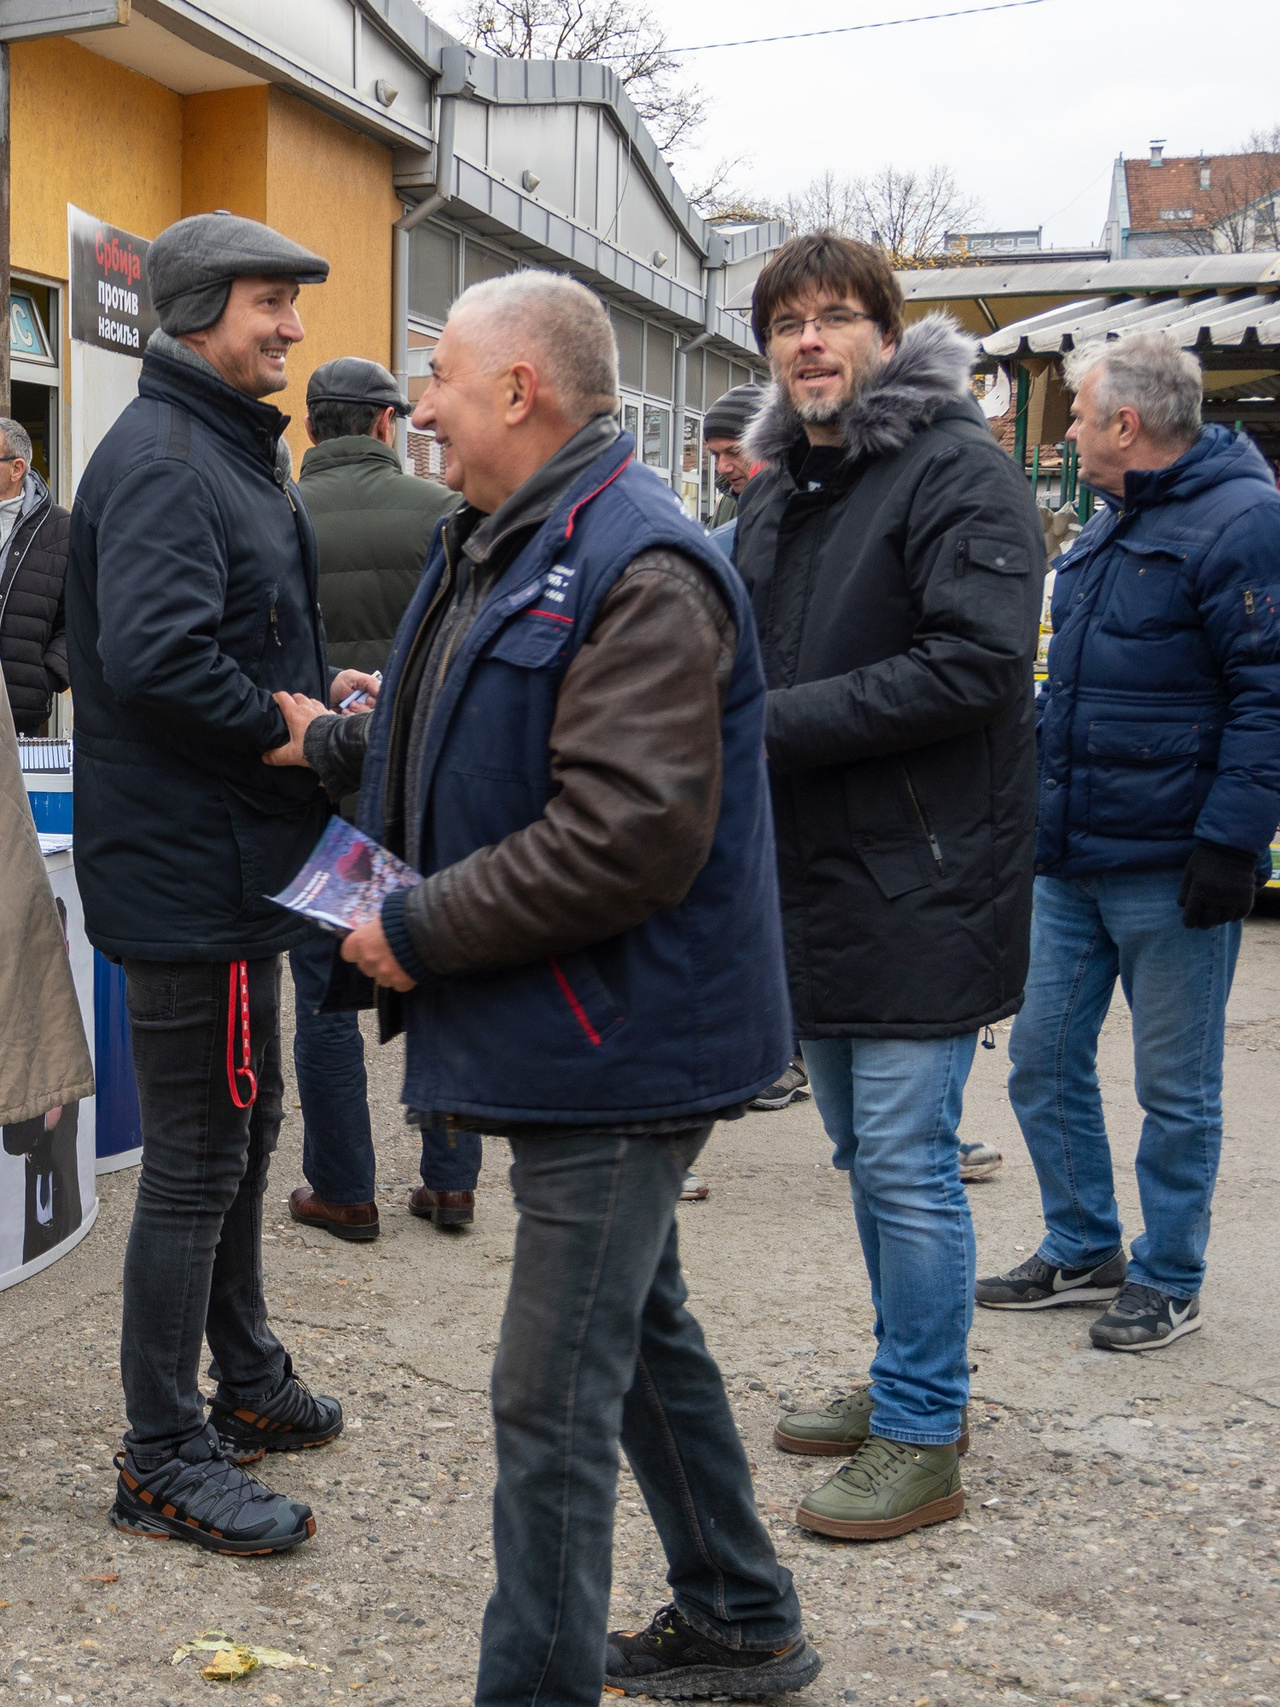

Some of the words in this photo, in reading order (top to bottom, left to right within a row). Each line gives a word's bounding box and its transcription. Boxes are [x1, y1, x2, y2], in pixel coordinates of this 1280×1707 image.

[95, 231, 140, 286] Србија
[98, 280, 139, 316] против
[98, 315, 140, 348] насиља
